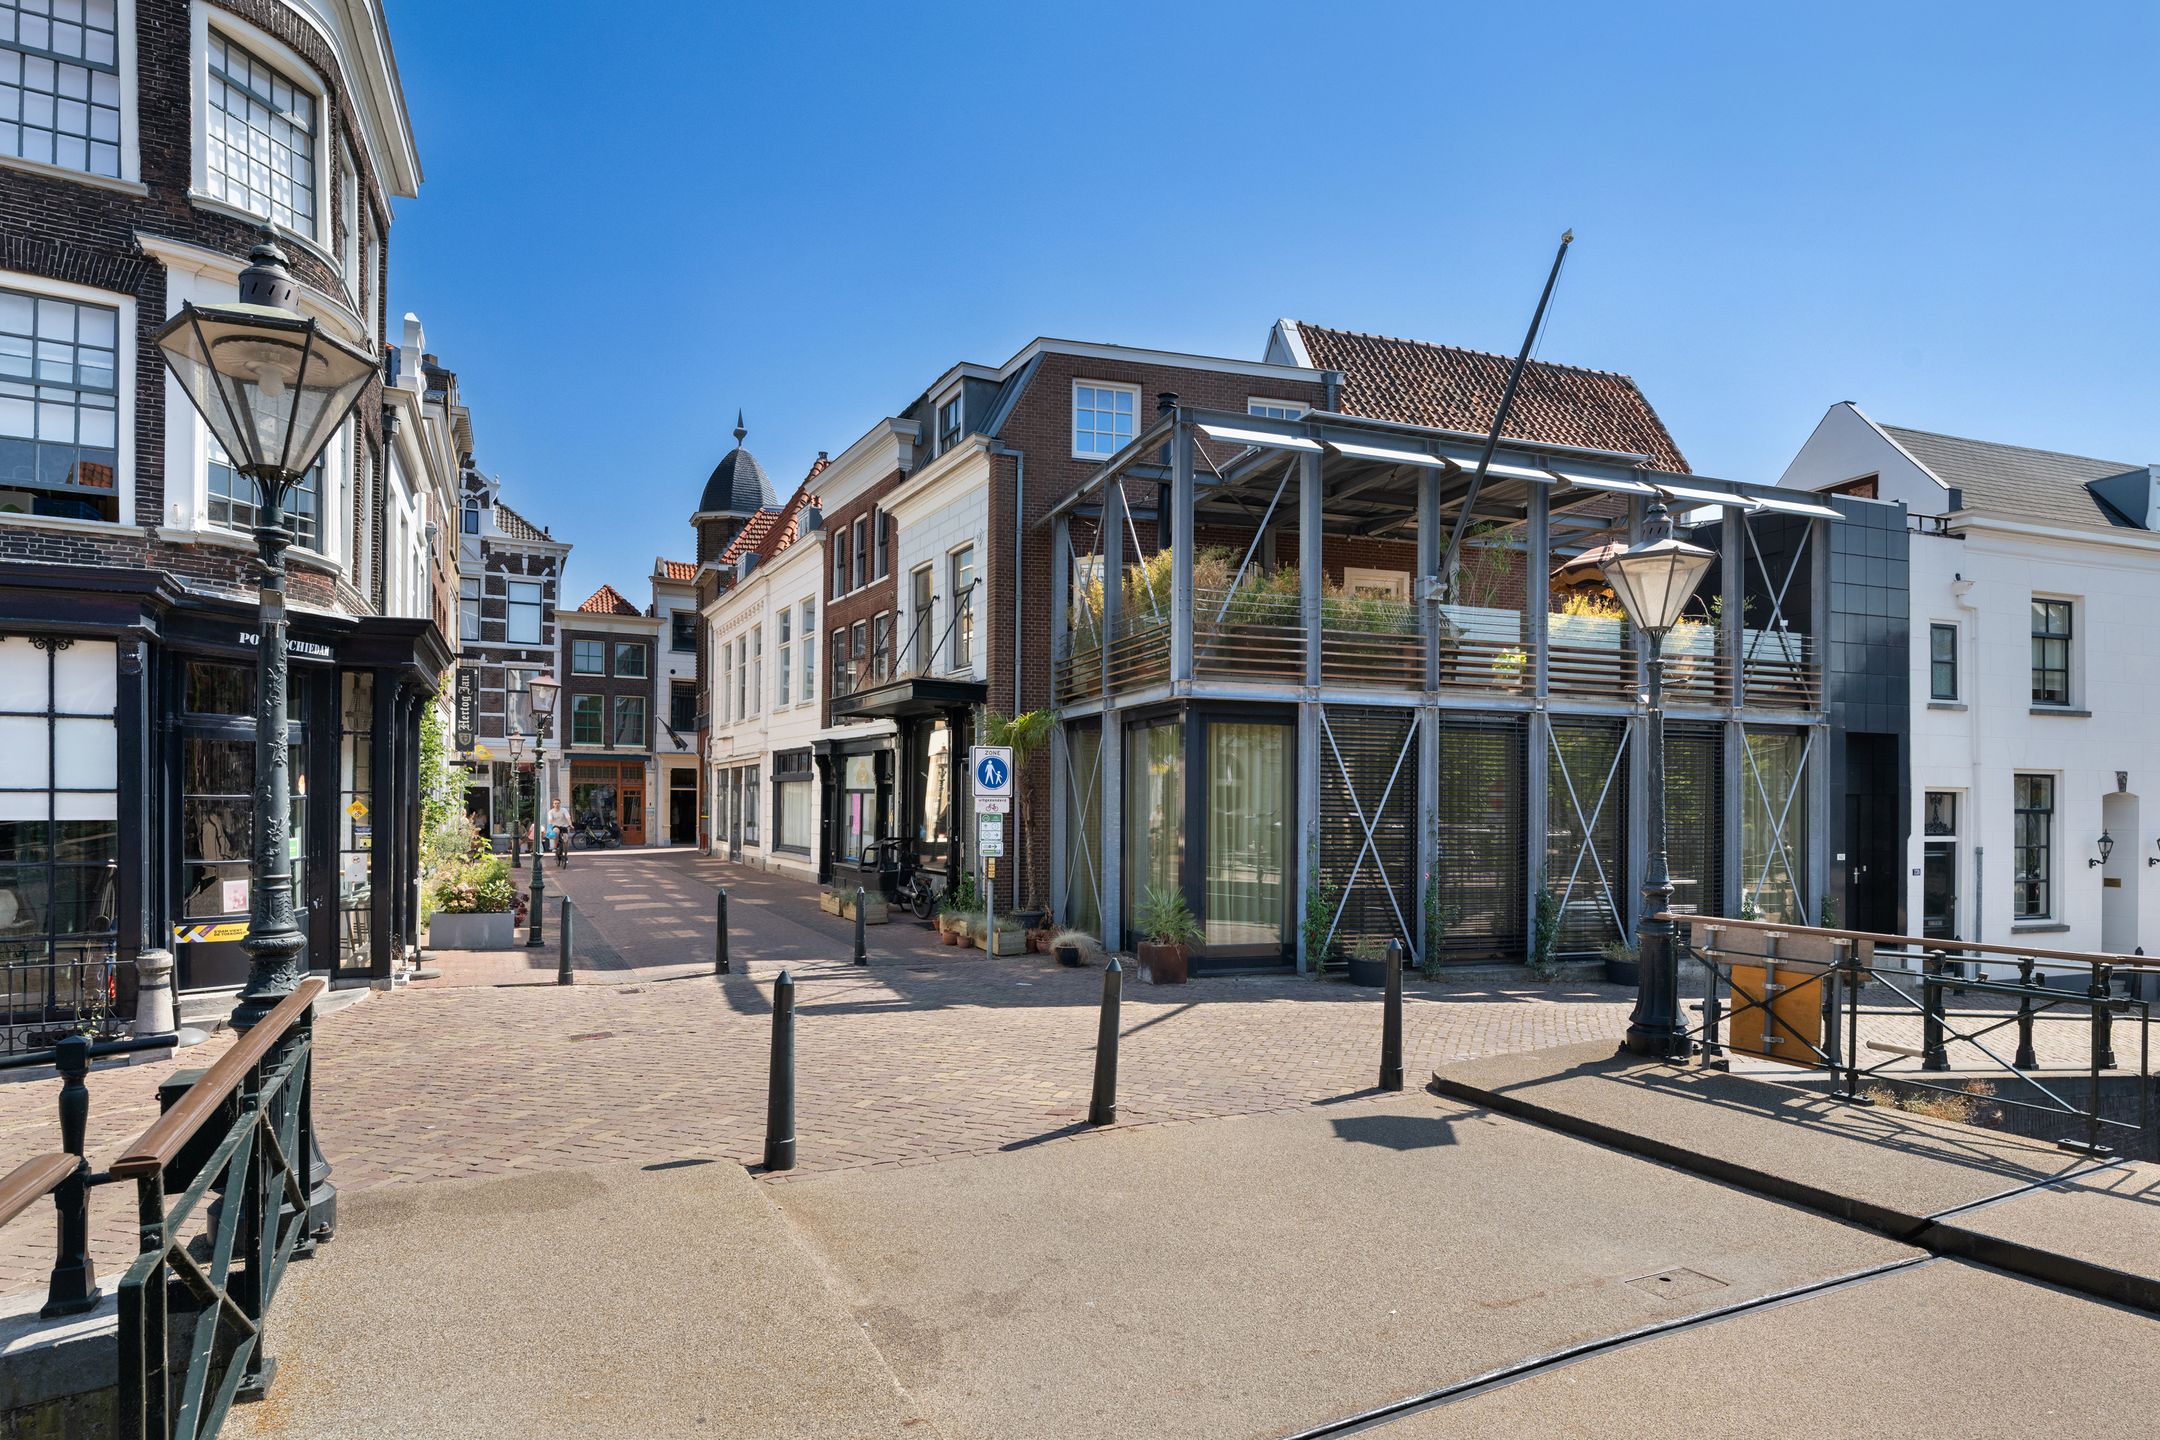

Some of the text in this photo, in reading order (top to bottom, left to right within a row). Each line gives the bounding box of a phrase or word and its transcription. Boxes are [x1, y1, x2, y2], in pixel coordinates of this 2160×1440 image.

[239, 632, 260, 645] PO
[458, 675, 473, 731] Hertog Jan
